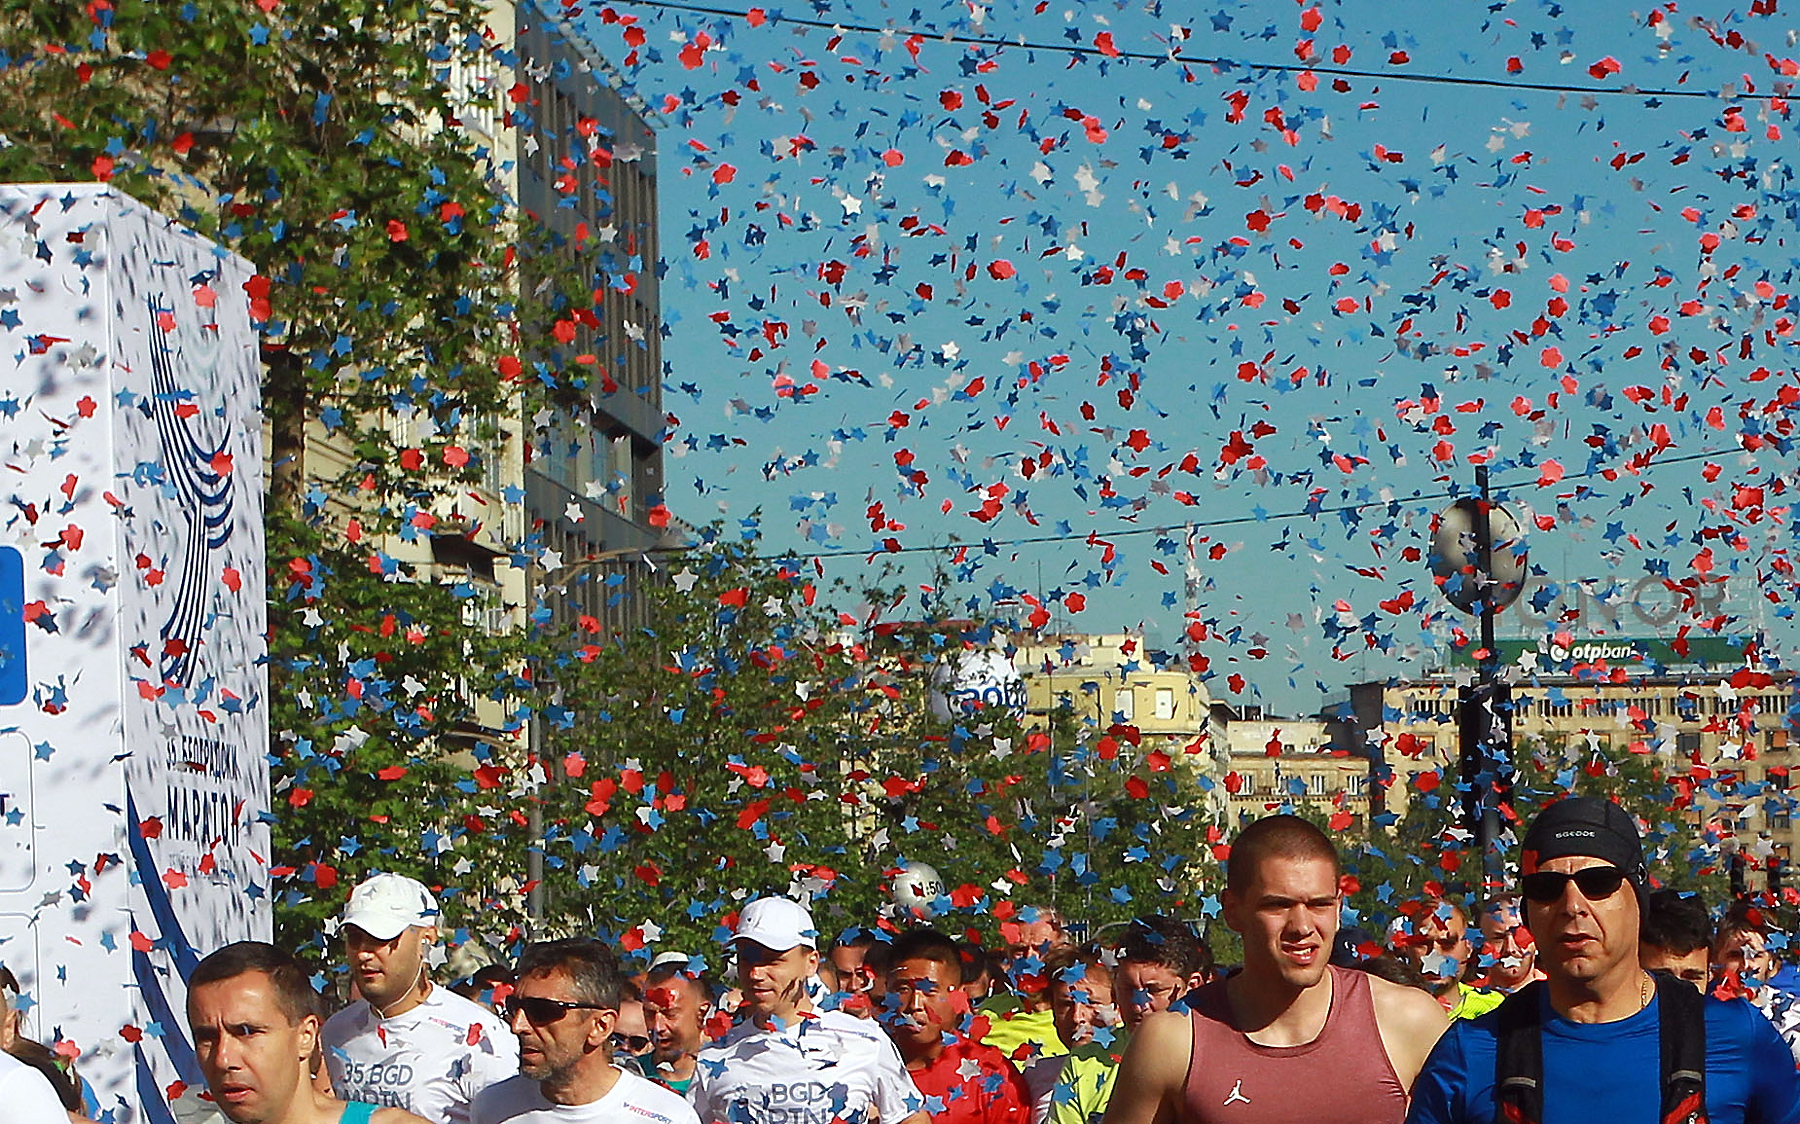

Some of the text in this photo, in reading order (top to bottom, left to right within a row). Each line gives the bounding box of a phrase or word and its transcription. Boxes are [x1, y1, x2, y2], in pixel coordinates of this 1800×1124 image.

[1512, 573, 1727, 627] ONOR
[1572, 641, 1642, 663] otpban
[167, 785, 240, 848] МАРАТОН
[343, 1063, 414, 1086] 35.BGD
